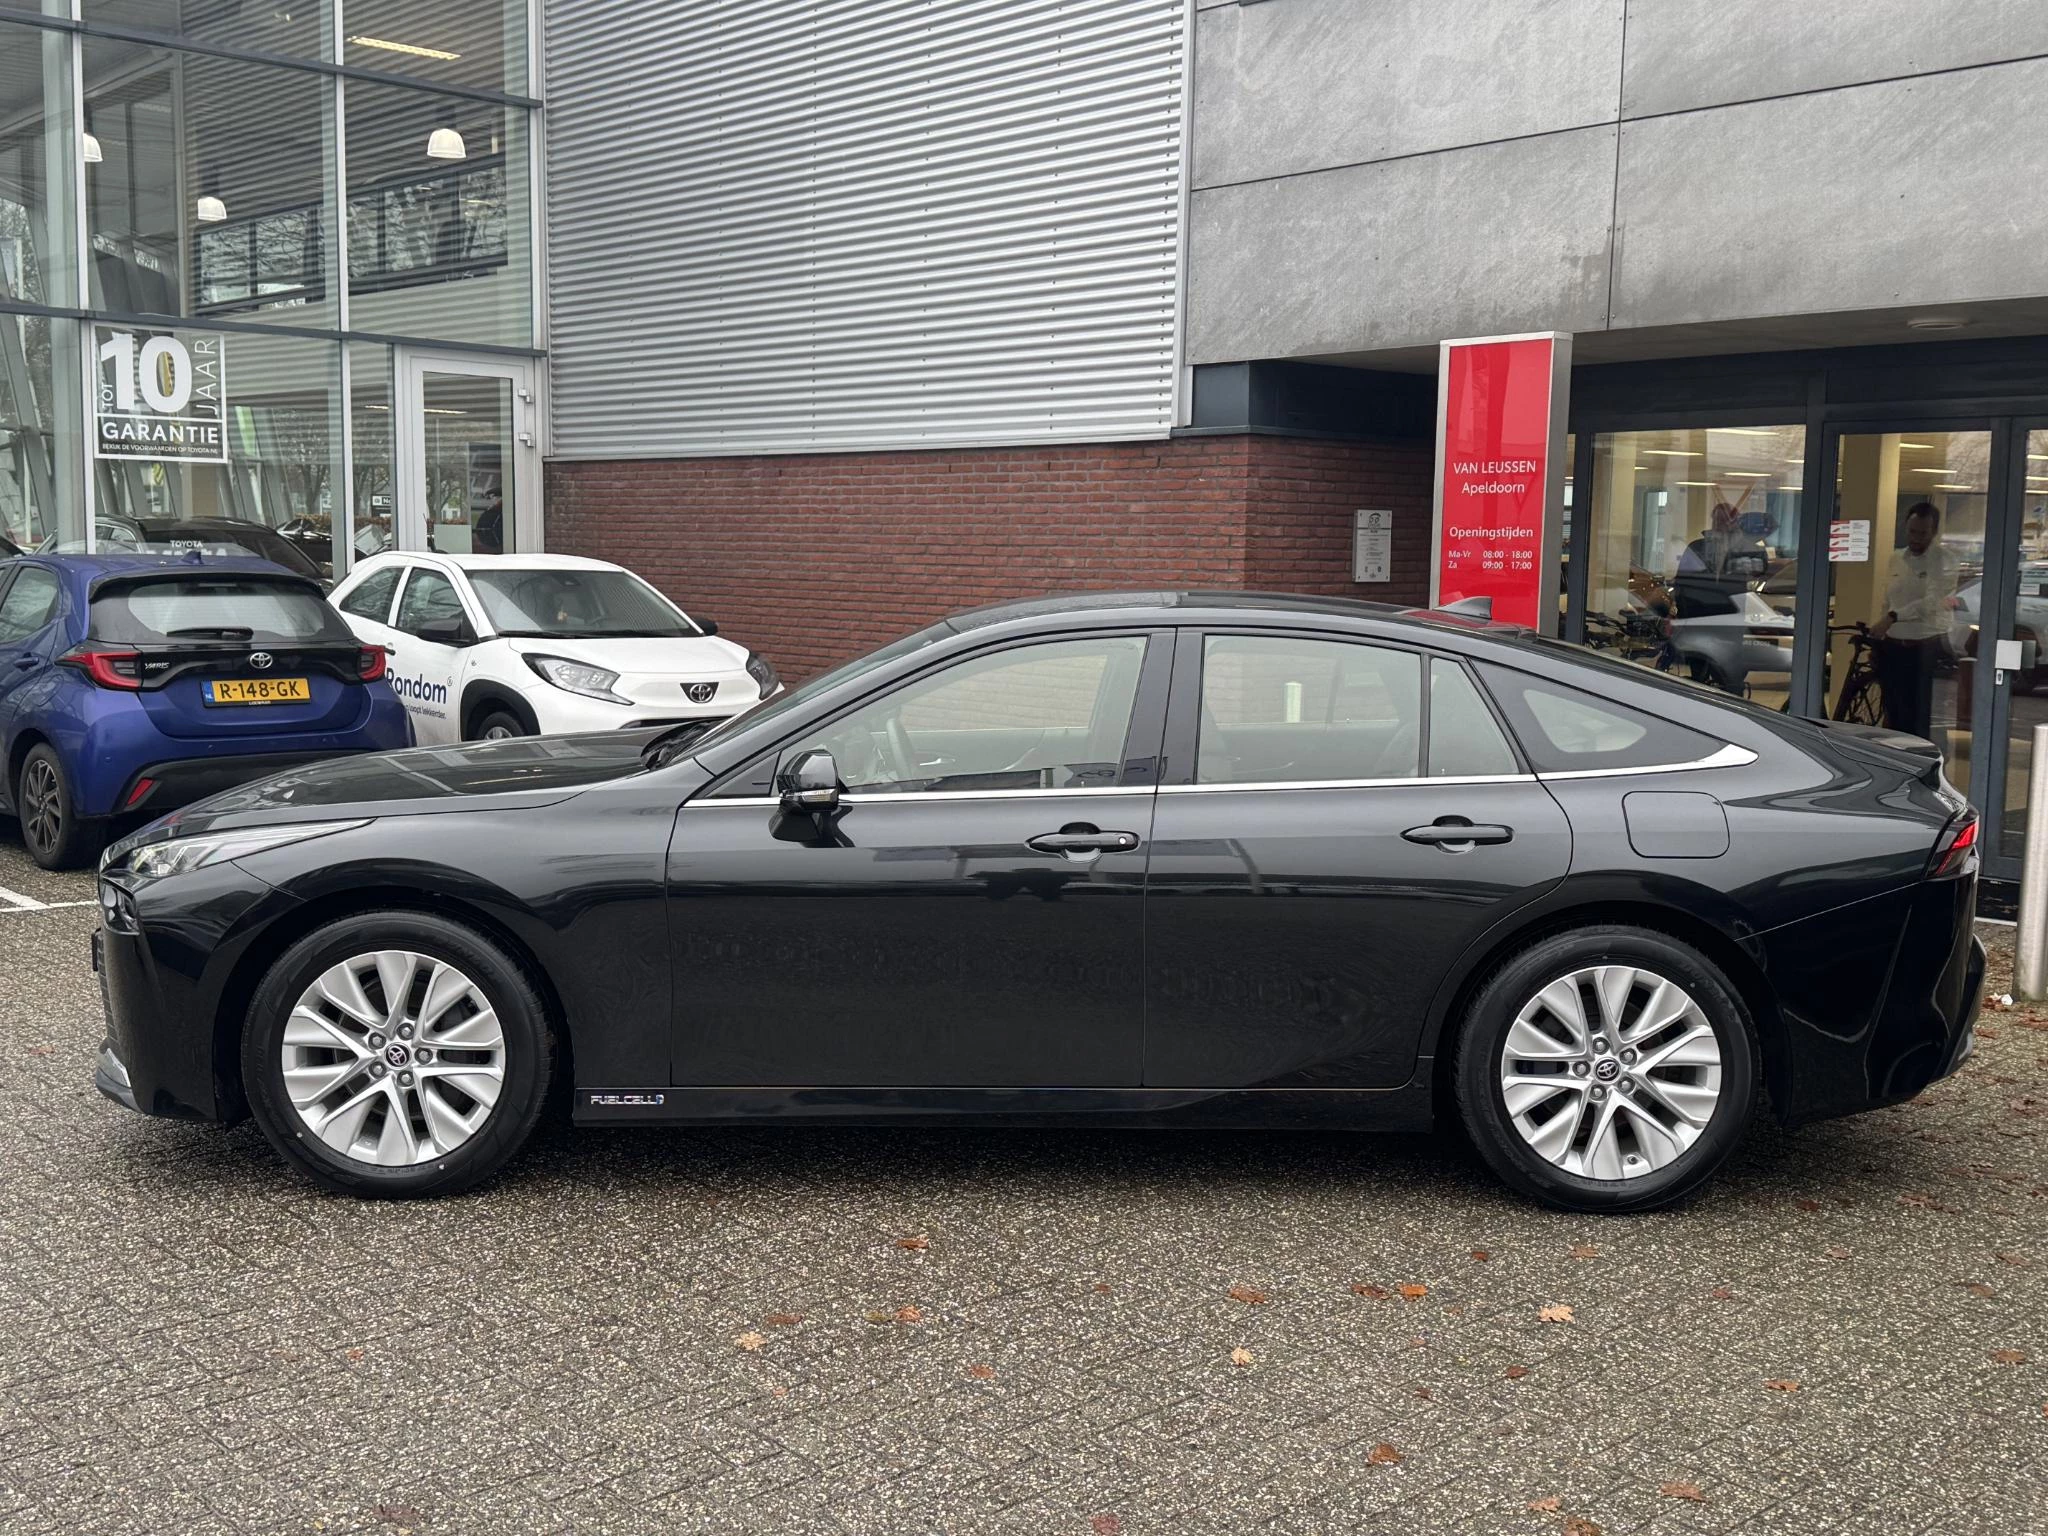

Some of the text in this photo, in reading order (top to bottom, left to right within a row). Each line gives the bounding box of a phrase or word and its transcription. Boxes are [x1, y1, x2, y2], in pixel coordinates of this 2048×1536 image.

[101, 331, 192, 413] 10
[194, 339, 217, 415] JAAR
[101, 382, 113, 409] TOT
[102, 422, 219, 444] GARANTIE
[1453, 460, 1537, 474] VAN LEUSSEN
[1461, 480, 1525, 496] Apeldoorn
[1449, 526, 1534, 540] Openingstijden
[169, 540, 204, 548] TOYOTA
[1448, 550, 1472, 558] Ma-Vr
[1482, 550, 1504, 559] 08:00
[1511, 550, 1533, 559] 18:00
[1448, 561, 1458, 569] Za
[1482, 561, 1504, 570] 09:00
[1511, 561, 1532, 570] 17:00
[144, 661, 170, 670] YARIS
[219, 681, 301, 699] R-148-GK
[386, 667, 447, 704] Rondom
